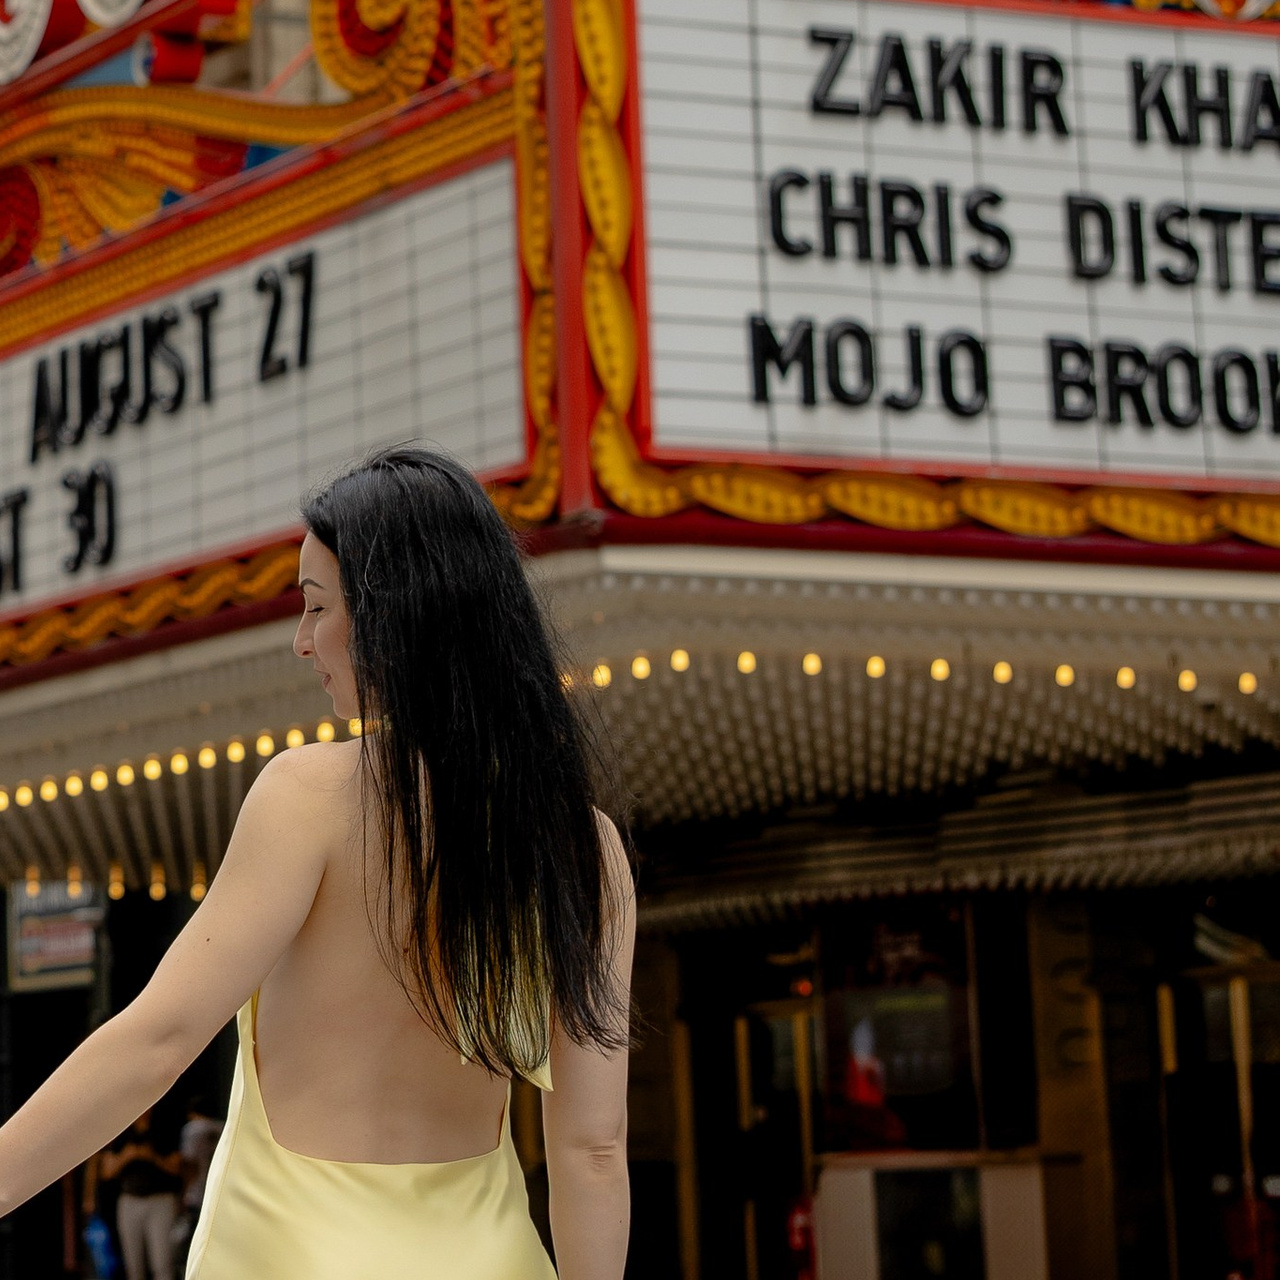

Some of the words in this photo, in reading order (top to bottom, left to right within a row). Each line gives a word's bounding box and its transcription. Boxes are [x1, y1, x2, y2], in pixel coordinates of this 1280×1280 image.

[808, 26, 1070, 139] ZAKIR
[767, 170, 1013, 276] CHRIS
[31, 291, 219, 463] AUGUST
[256, 251, 315, 382] 27
[748, 314, 990, 419] MOJO
[1047, 336, 1280, 436] BROO
[61, 461, 116, 573] 30
